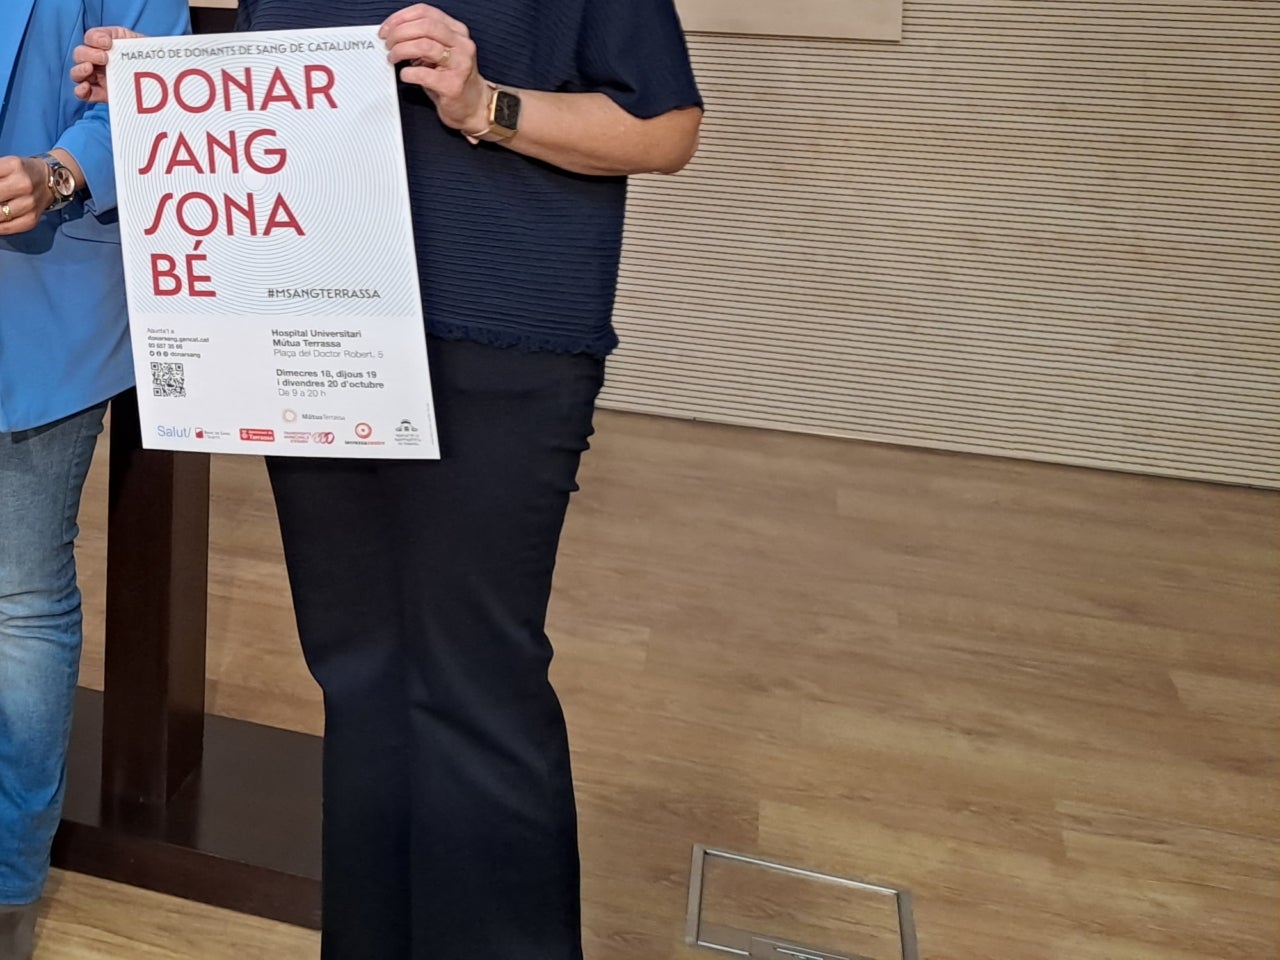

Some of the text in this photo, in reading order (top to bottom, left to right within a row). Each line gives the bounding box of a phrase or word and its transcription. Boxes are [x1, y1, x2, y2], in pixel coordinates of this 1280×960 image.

[121, 40, 375, 61] MARATÓ DE DONANTS DE SANG DE CATALUNYA
[133, 64, 338, 114] DONAR
[138, 128, 288, 176] SANG
[144, 190, 306, 237] SONA
[150, 240, 217, 298] BÉ
[267, 288, 381, 299] #MSANGTERRASSA
[271, 329, 362, 339] Hospital Universitari
[272, 338, 342, 348] Mútua Terrassa
[273, 348, 297, 358] Plaça
[298, 349, 311, 357] del
[313, 349, 342, 358] Doctor
[377, 351, 384, 359] 5
[276, 368, 377, 380] Dimecres 18, dijous 19
[282, 379, 325, 388] divendres
[327, 380, 338, 388] 20
[340, 380, 385, 389] d'octubre
[278, 388, 290, 397] De
[291, 389, 298, 397] 9
[308, 389, 319, 397] 20
[320, 389, 327, 397] h
[156, 425, 192, 439] Salut/
